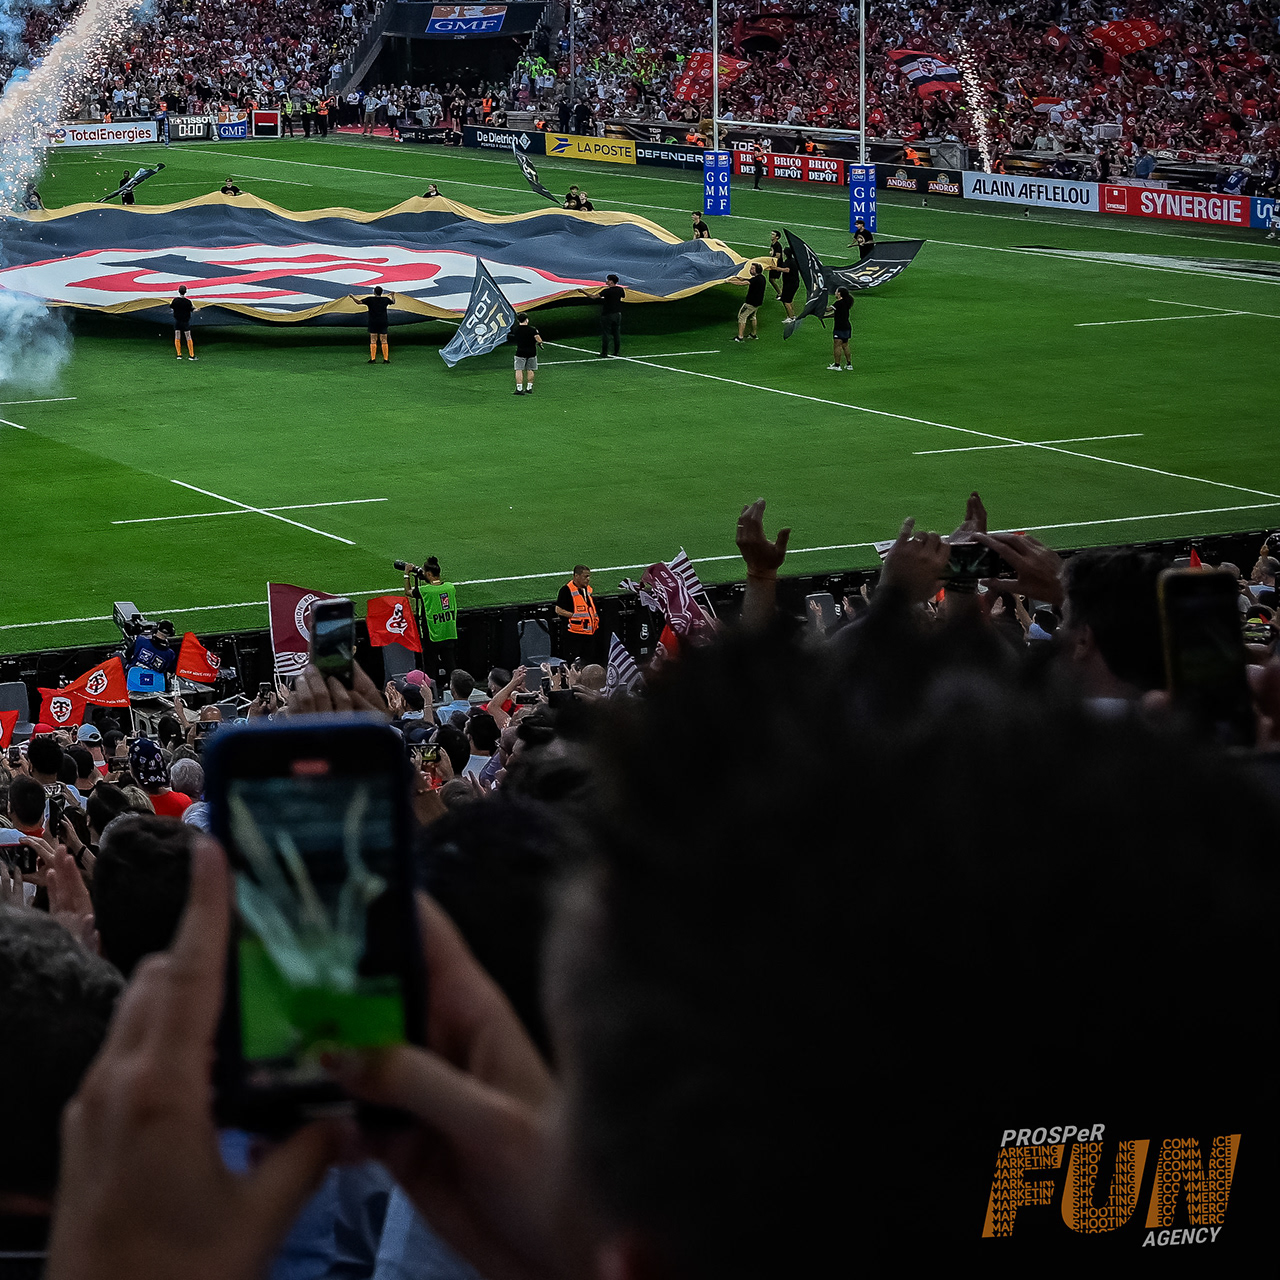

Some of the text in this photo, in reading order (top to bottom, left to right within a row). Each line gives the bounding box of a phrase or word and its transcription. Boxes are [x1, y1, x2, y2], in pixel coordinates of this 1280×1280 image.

[434, 19, 498, 32] GMF
[181, 116, 212, 125] TISSOT
[68, 127, 152, 141] TotalEnergies
[179, 124, 203, 136] 0:00
[220, 126, 245, 137] GMF
[477, 131, 519, 145] De Dietrich
[577, 142, 632, 158] LA POSTE
[637, 148, 704, 163] DEFENDER
[740, 153, 768, 164] BRO
[774, 156, 802, 168] BRICO
[808, 159, 837, 170] BRICO
[706, 171, 715, 210] GMF
[718, 171, 728, 210] GMF
[886, 178, 918, 190] ANDROS
[928, 181, 960, 195] ANDROS
[971, 179, 1090, 205] ALAIN AFFLELOU
[1141, 191, 1242, 223] SYNERGIE
